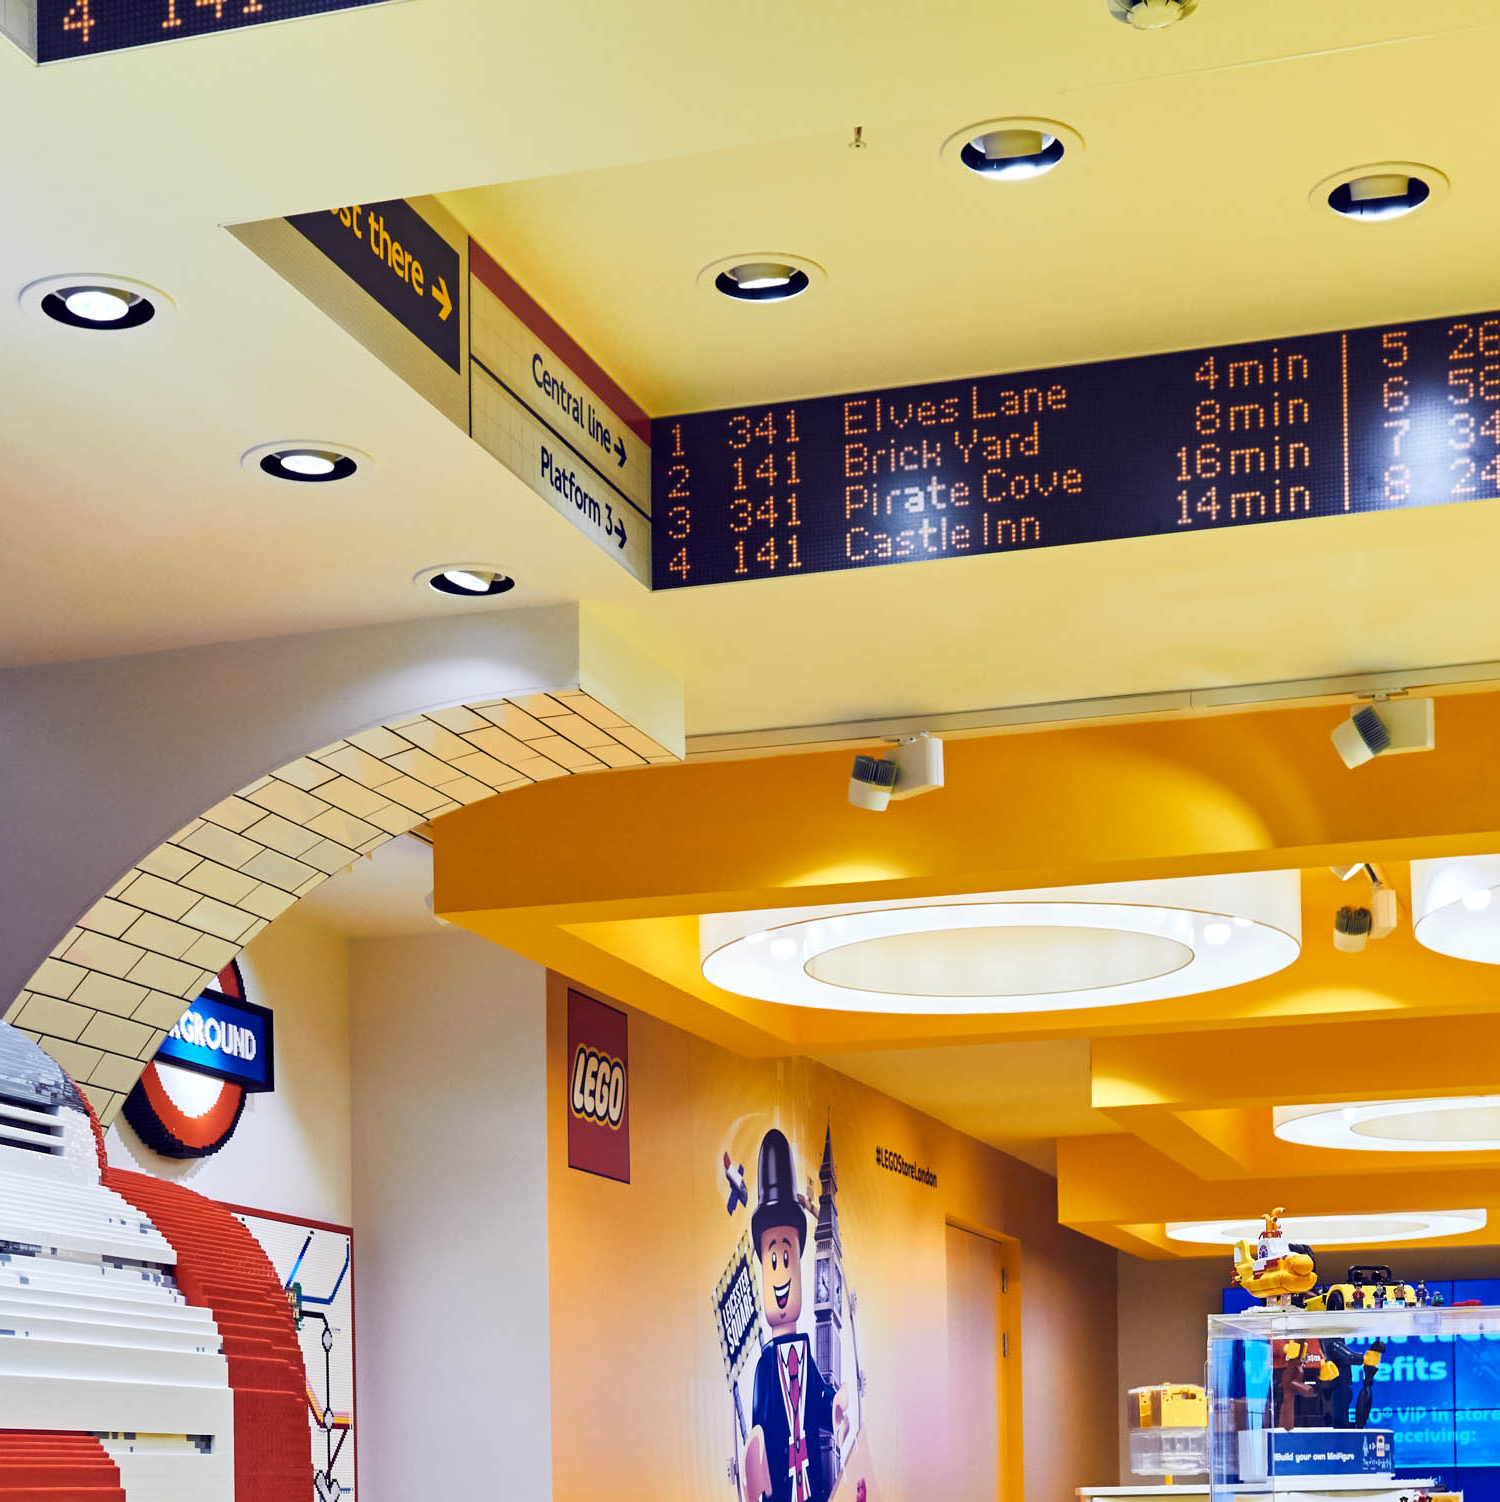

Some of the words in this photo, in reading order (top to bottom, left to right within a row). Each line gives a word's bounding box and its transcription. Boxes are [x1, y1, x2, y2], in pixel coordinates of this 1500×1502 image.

[330, 207, 363, 239] st
[368, 215, 425, 297] there
[1381, 331, 1410, 367] 5
[532, 353, 585, 426] Central
[587, 406, 612, 456] line
[670, 424, 686, 457] 1
[727, 410, 801, 451] 341
[844, 394, 960, 437] Elves
[972, 383, 1068, 423] Lane
[1381, 374, 1411, 413] 6
[541, 445, 602, 528] Platform
[604, 503, 615, 537] 3
[669, 466, 691, 500] 2
[732, 450, 802, 493] 141
[844, 436, 941, 481] Brick
[954, 421, 1041, 465] Yard
[1383, 462, 1411, 502] 8
[669, 507, 692, 540] 3
[730, 492, 802, 535] 341
[844, 477, 970, 522] Pirate
[982, 466, 1083, 504] Cove
[669, 547, 692, 581] 4
[733, 533, 803, 576] 141
[845, 517, 972, 563] Castle
[982, 512, 1042, 548] Inn
[571, 1046, 626, 1129] LEGO
[876, 1145, 938, 1189] #LEGOStoreLondon
[722, 1266, 750, 1330] LEICESTER
[727, 1286, 755, 1355] SQUARE
[1351, 1355, 1447, 1382] nefits
[1394, 1428, 1476, 1445] eceiving:
[1432, 1407, 1449, 1422] in
